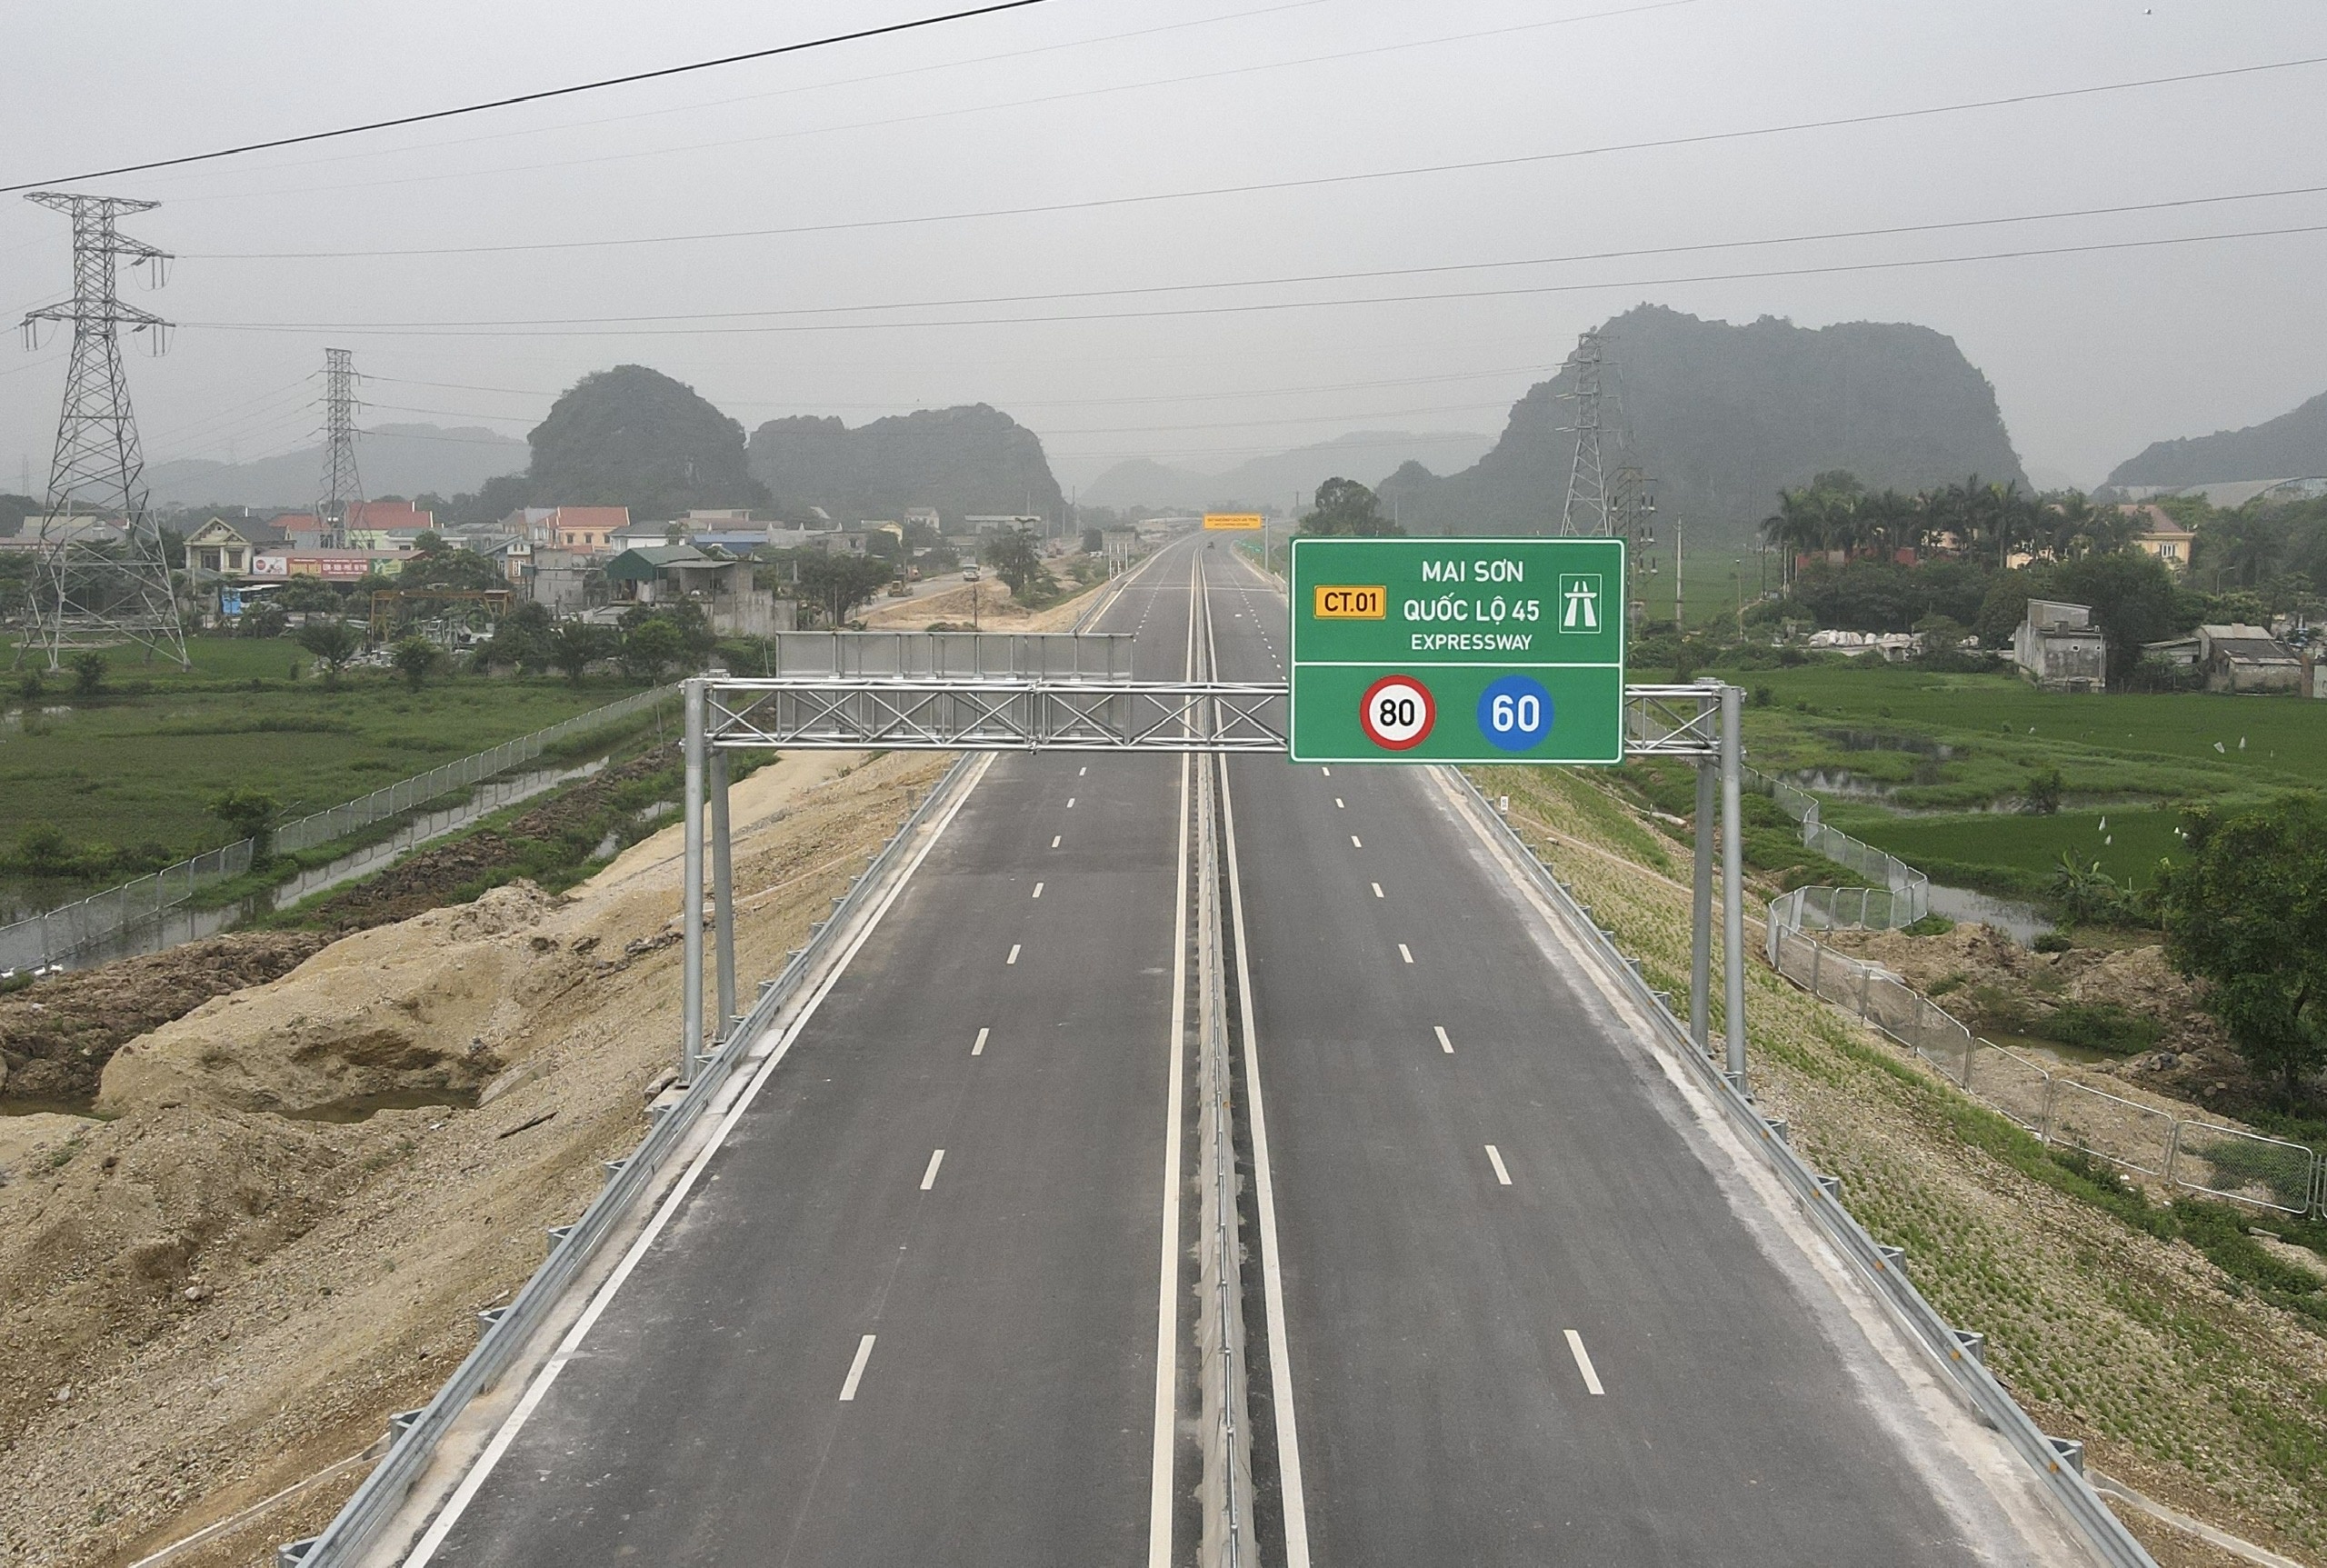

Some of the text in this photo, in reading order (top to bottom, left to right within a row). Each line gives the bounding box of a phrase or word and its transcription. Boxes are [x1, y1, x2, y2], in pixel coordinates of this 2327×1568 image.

[1422, 557, 1523, 583] MAI SƠN
[1324, 592, 1377, 613] CT.01
[1403, 592, 1540, 625] QUỐC LỘ 45
[1411, 634, 1533, 651] EXPRESSWAY
[1379, 698, 1415, 727] 80
[1492, 694, 1540, 733] 60
